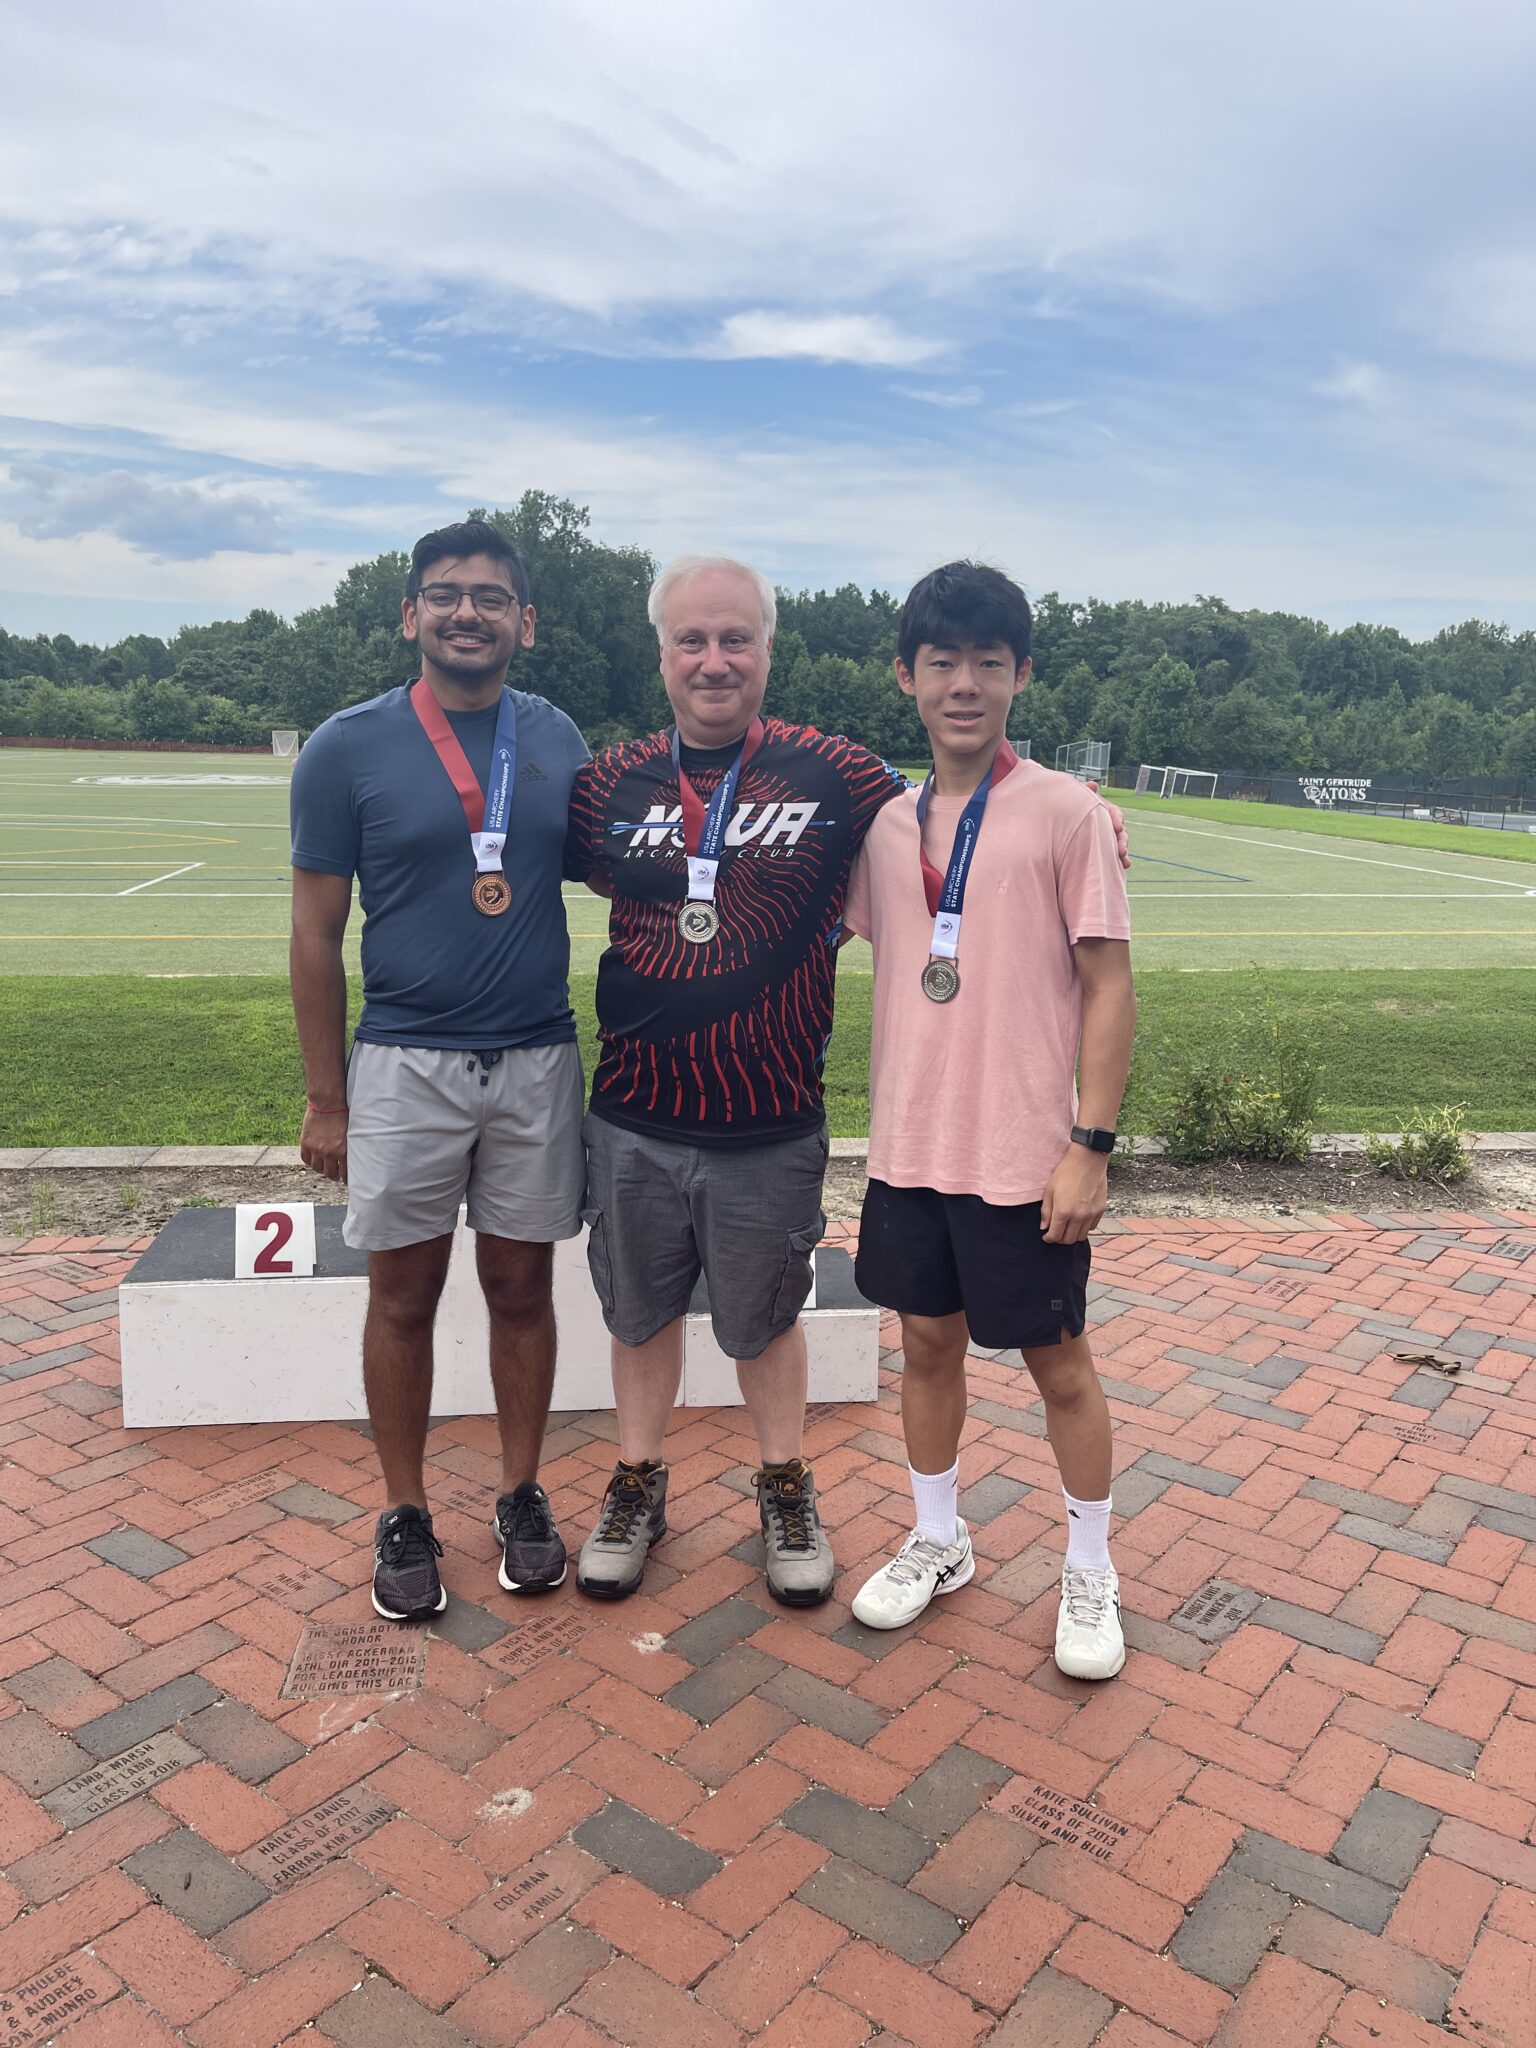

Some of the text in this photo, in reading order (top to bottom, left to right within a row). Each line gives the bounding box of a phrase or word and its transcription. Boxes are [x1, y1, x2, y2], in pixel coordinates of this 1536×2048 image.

[495, 762, 510, 828] STATE CHAMPIONSHIPS
[1298, 777, 1372, 787] SAINT GERTRUDE
[491, 789, 500, 815] ARCHERY
[709, 783, 730, 855] STATE CHAMPIONSHIPS
[705, 813, 716, 843] ARCHERY
[737, 849, 796, 858] CLUB
[950, 833, 972, 908] STATE CHAMPIONSHIPS
[947, 865, 958, 894] ARCHERY
[254, 1211, 294, 1274] 2
[1396, 1432, 1428, 1442] FAMILY
[191, 1488, 231, 1506] VICTORIA
[260, 1581, 289, 1598] FAMILY
[308, 1630, 329, 1639] THE
[342, 1635, 382, 1645] HONOR
[498, 1614, 580, 1665] PURPLE AND WHITE
[499, 1615, 558, 1649] VICKY SMITH
[295, 1661, 324, 1672] ATHL
[329, 1659, 350, 1669] DIR
[347, 1646, 415, 1658] ACKERMAN
[520, 1646, 552, 1666] CLASS
[550, 1638, 563, 1649] OF
[290, 1680, 349, 1692] BUILDING
[355, 1679, 383, 1689] THIS
[293, 1666, 415, 1682] FOR LEADERSHIP IN
[67, 1743, 155, 1794] LAMB MARSH
[86, 1758, 181, 1813] CLASS OF 2018
[120, 1758, 155, 1780] LAMB
[257, 1825, 302, 1856] HAILEY
[313, 1796, 351, 1822] DAVIS
[1024, 1796, 1119, 1847] CLASS OF 2013
[1033, 1785, 1129, 1836] KATIE SULLIVAN
[272, 1806, 361, 1864] CLASS OF 2017
[272, 1806, 389, 1884] FARRAN KIM & VAN
[1008, 1804, 1115, 1861] SILVER AND BLUE
[493, 1869, 551, 1911] COLEMAN
[522, 1884, 566, 1921] FAMILY
[0, 1962, 80, 2012] & PHOEBE
[25, 1976, 84, 2018] AUDREY
